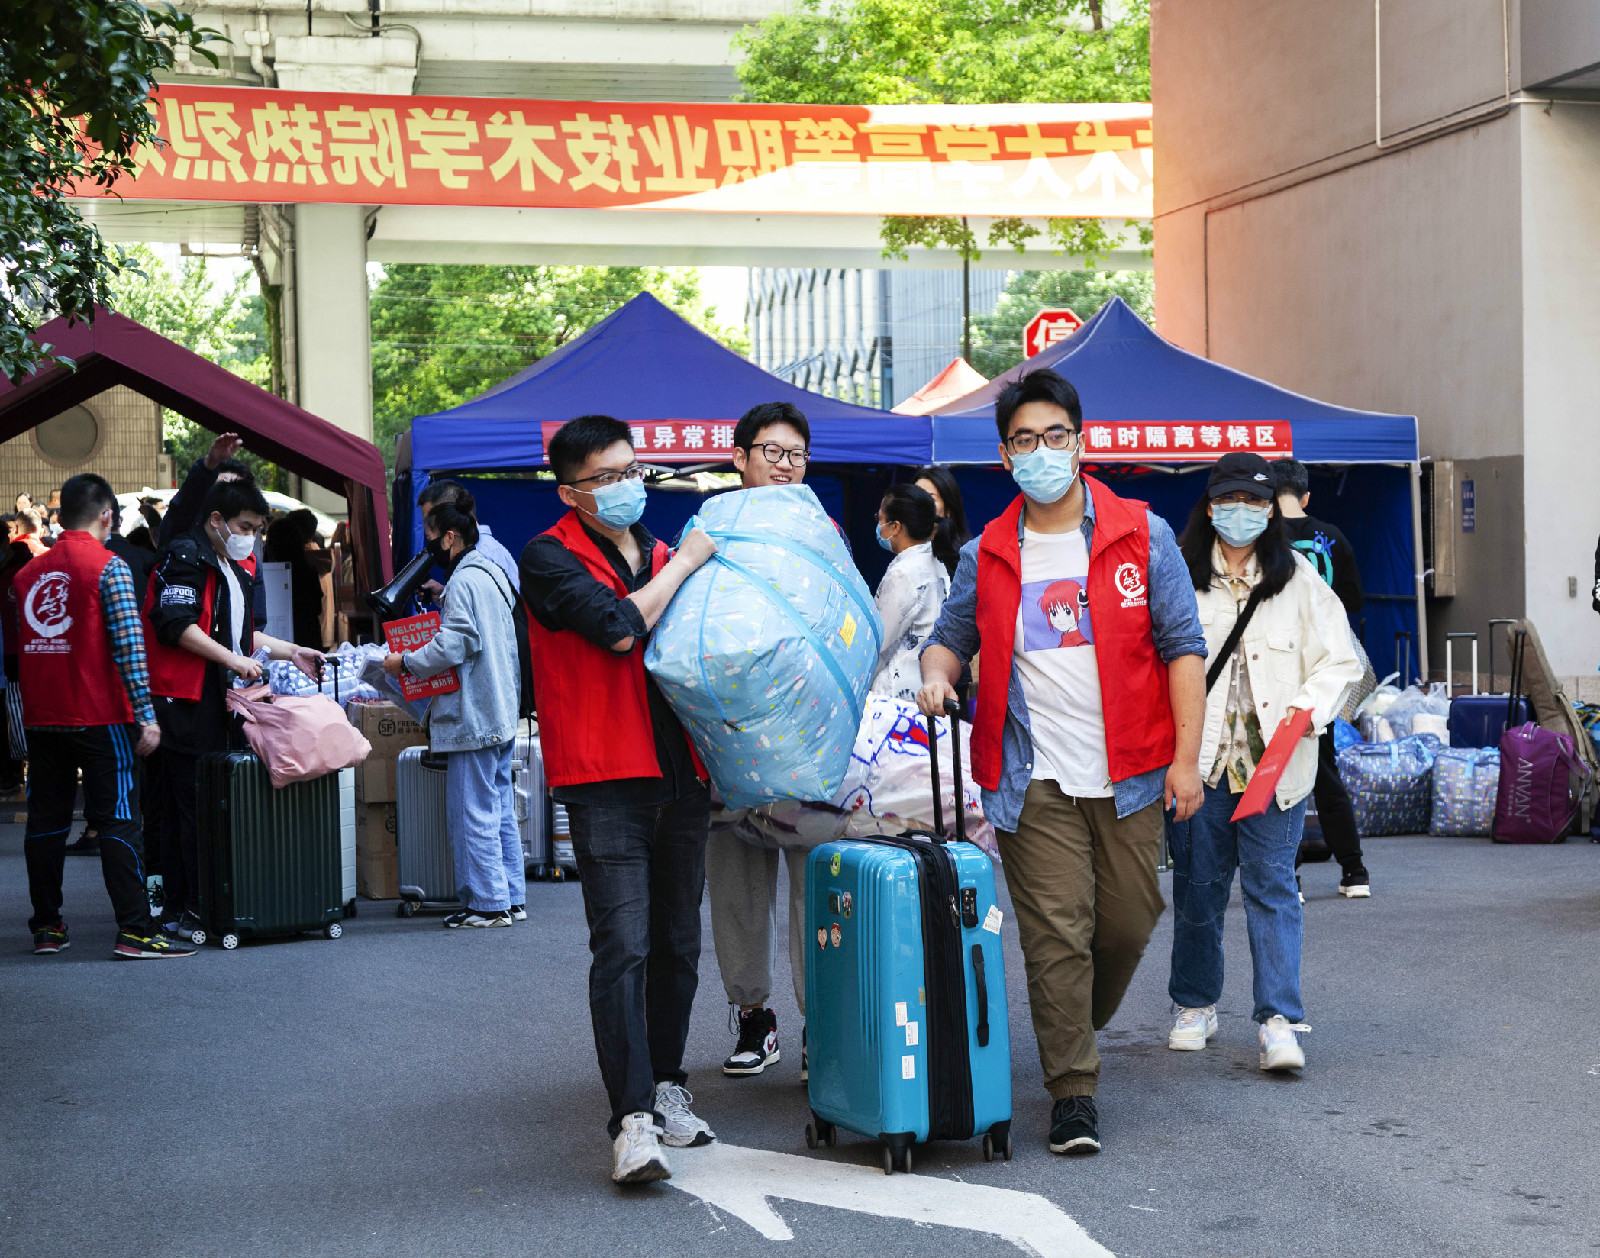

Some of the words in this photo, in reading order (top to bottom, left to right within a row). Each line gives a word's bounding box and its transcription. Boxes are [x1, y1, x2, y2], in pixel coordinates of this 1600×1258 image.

[1033, 318, 1076, 352] 停
[1090, 424, 1277, 449] 临时隔离等候区
[388, 618, 438, 637] WELCOME
